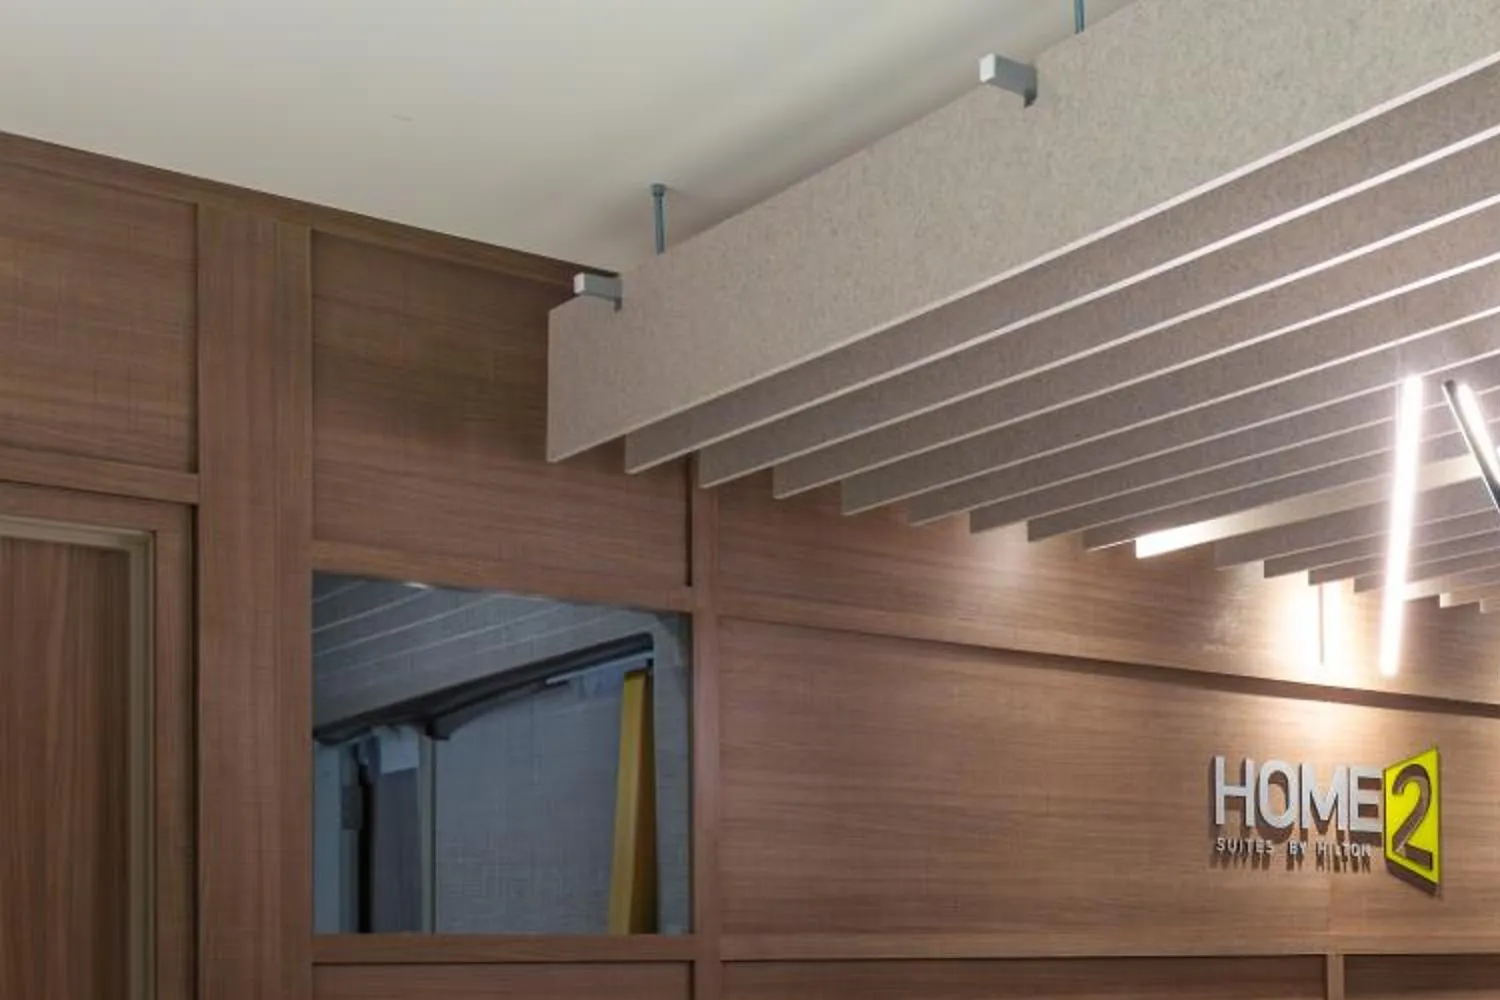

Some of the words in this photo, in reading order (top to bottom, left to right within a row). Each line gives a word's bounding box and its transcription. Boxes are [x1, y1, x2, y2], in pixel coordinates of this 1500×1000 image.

[1215, 837, 1274, 854] SUITES
[1289, 840, 1308, 856] BY
[1316, 841, 1372, 858] HILTON
